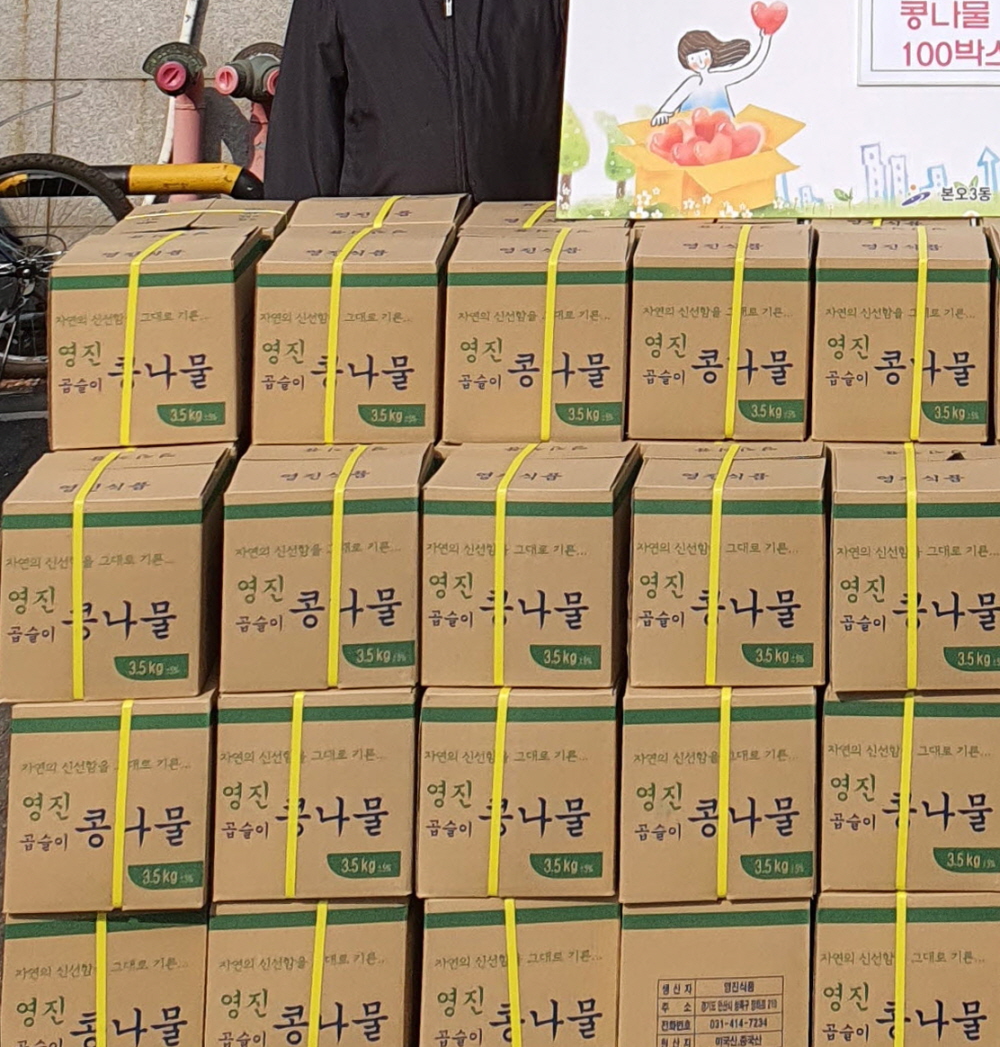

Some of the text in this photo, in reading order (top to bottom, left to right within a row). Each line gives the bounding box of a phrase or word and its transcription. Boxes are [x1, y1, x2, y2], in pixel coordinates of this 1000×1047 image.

[901, 1, 989, 30] 콩나물
[941, 184, 993, 203] 본오3동
[825, 308, 857, 319] 자연의
[59, 341, 100, 367] 영진
[263, 339, 304, 364] 영진
[461, 338, 502, 363] 영진
[645, 333, 686, 358] 영진
[828, 334, 869, 359] 영진
[459, 352, 610, 390] 곱슬이 콩나물
[643, 349, 793, 385] 곱슬이 콩나물
[826, 350, 975, 387] 곱슬이 콩나물
[59, 378, 101, 393] 곱슬이
[637, 543, 670, 554] 자연의
[726, 543, 760, 554] 그대로
[238, 575, 283, 603] 영진
[429, 572, 472, 599] 영진
[640, 571, 683, 599] 영진
[841, 575, 885, 603] 영진
[9, 586, 54, 614] 영진
[236, 588, 402, 632] 곱슬이 콩나물
[429, 610, 473, 627] 곱슬이
[639, 611, 684, 628] 곱슬이
[8, 626, 54, 643] 곱슬이
[223, 781, 268, 810] 영진
[427, 780, 471, 808] 영진
[637, 782, 682, 811] 영진
[831, 774, 875, 802] 영진
[23, 792, 69, 821] 영진
[635, 797, 800, 841] 곱슬이 콩나물
[20, 806, 191, 851] 곱슬이 콩나물
[222, 822, 268, 839] 곱슬이
[830, 813, 875, 831] 곱슬이
[724, 981, 754, 993] 영진식품
[824, 982, 868, 1011] 영진
[17, 996, 64, 1027] 영진
[221, 988, 267, 1019] 영진
[438, 986, 483, 1017] 영진
[219, 1001, 388, 1047] 곱슬이 콩나물
[435, 1028, 482, 1047] 곱슬이
[662, 1018, 767, 1032] 전화번호 031-414-7234
[823, 1024, 869, 1041] 곱슬이
